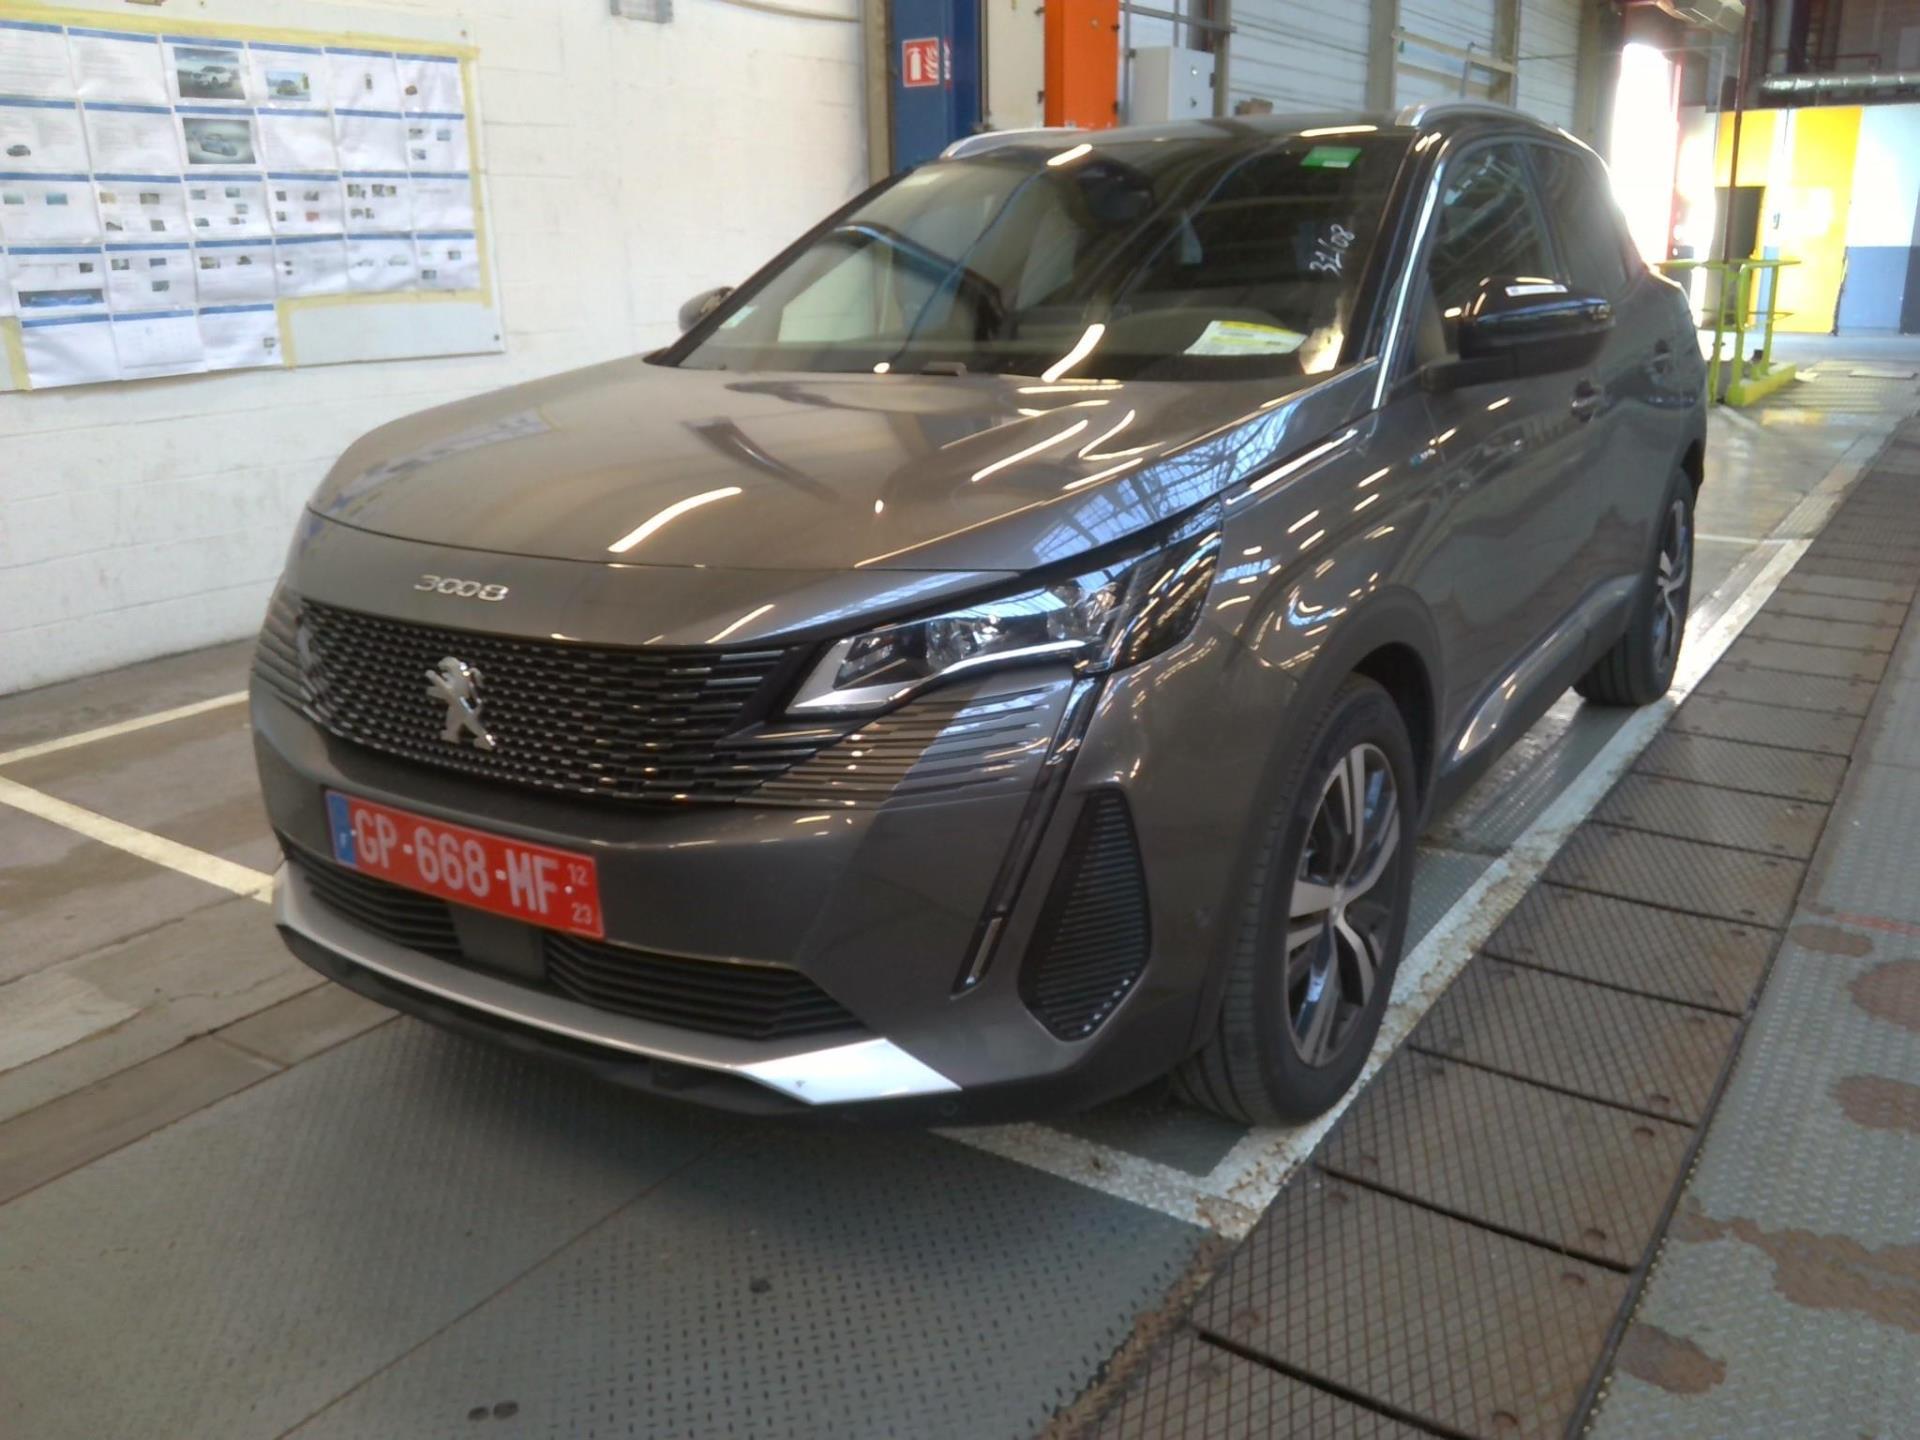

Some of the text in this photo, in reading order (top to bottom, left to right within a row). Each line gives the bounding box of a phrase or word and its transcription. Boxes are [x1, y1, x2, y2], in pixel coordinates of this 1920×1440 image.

[413, 574, 509, 601] 3008
[567, 863, 588, 886] 12
[571, 902, 593, 924] 23
